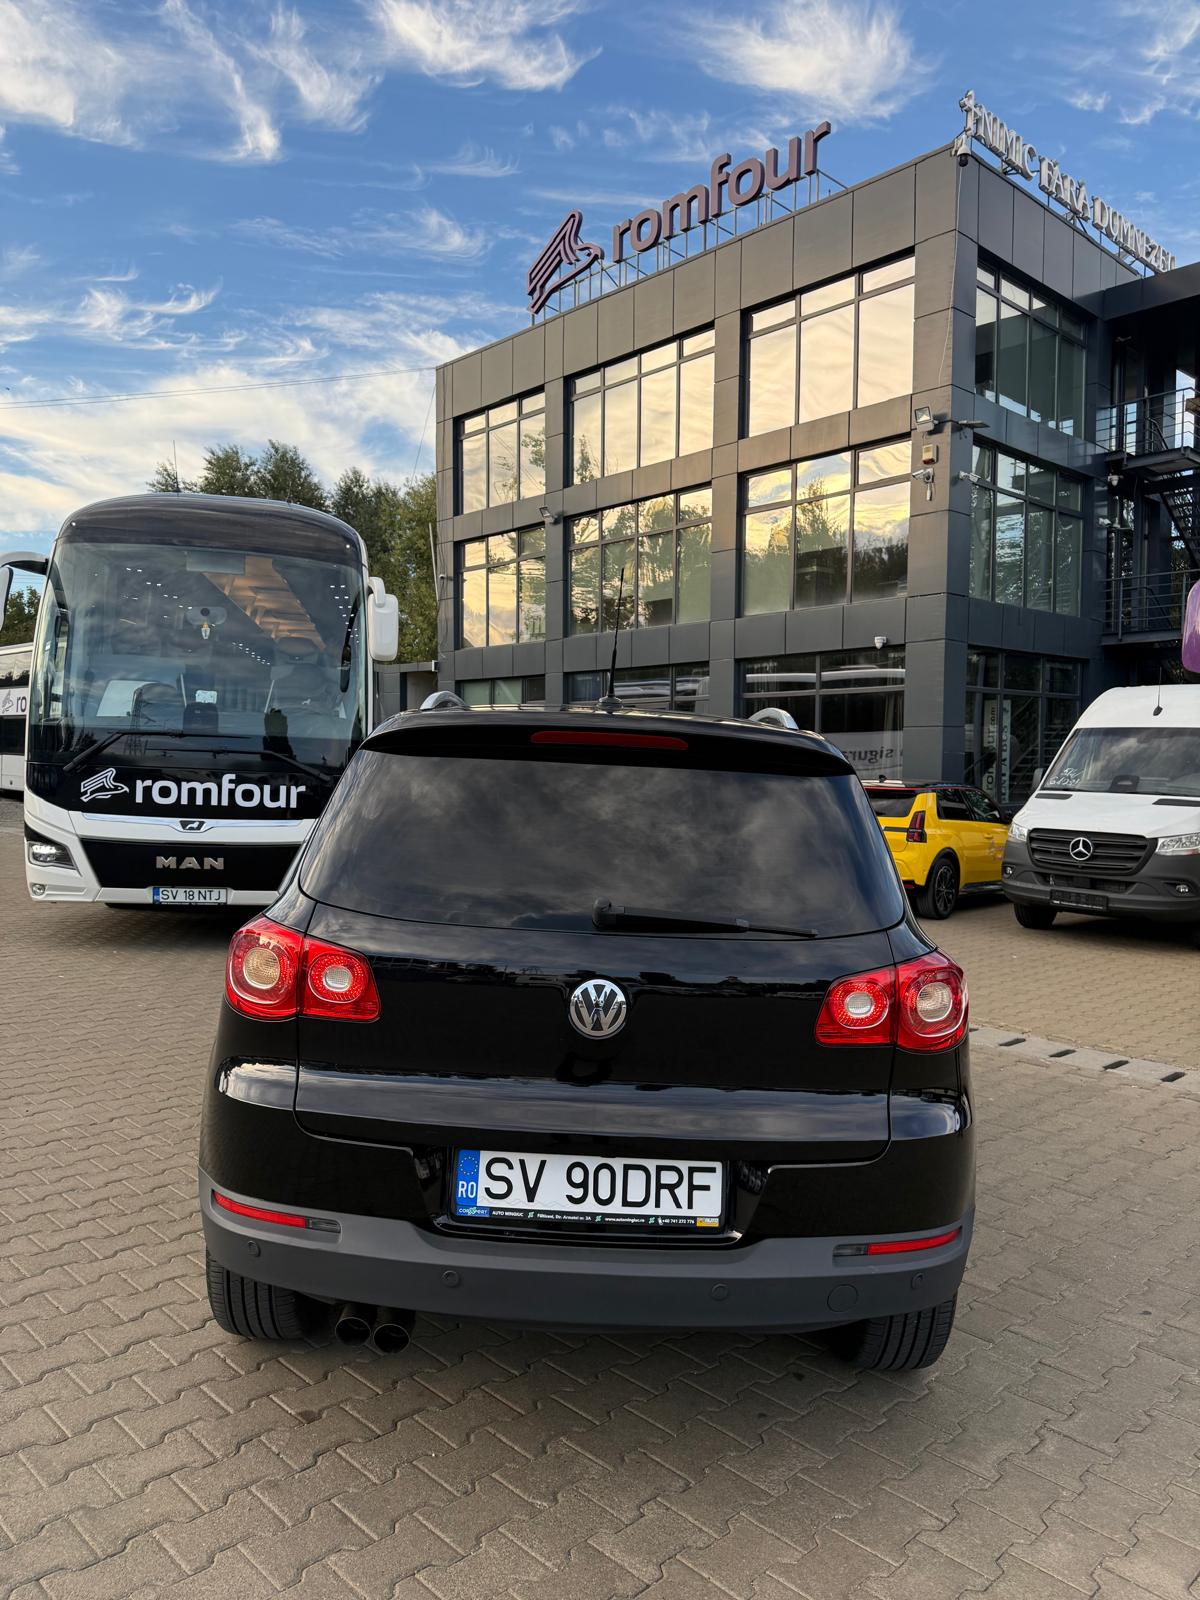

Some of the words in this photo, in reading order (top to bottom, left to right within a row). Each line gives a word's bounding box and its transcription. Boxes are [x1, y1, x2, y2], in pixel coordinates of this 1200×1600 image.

[612, 121, 831, 263] romfour
[974, 104, 1037, 181] NIMIC
[1092, 195, 1176, 274] DUMNEZEU
[135, 773, 306, 809] romfour
[155, 855, 225, 870] MAN
[160, 889, 179, 901] SV
[183, 889, 195, 901] 18
[197, 889, 221, 901] NTJ
[457, 1180, 477, 1199] RO
[484, 1157, 547, 1203] SV
